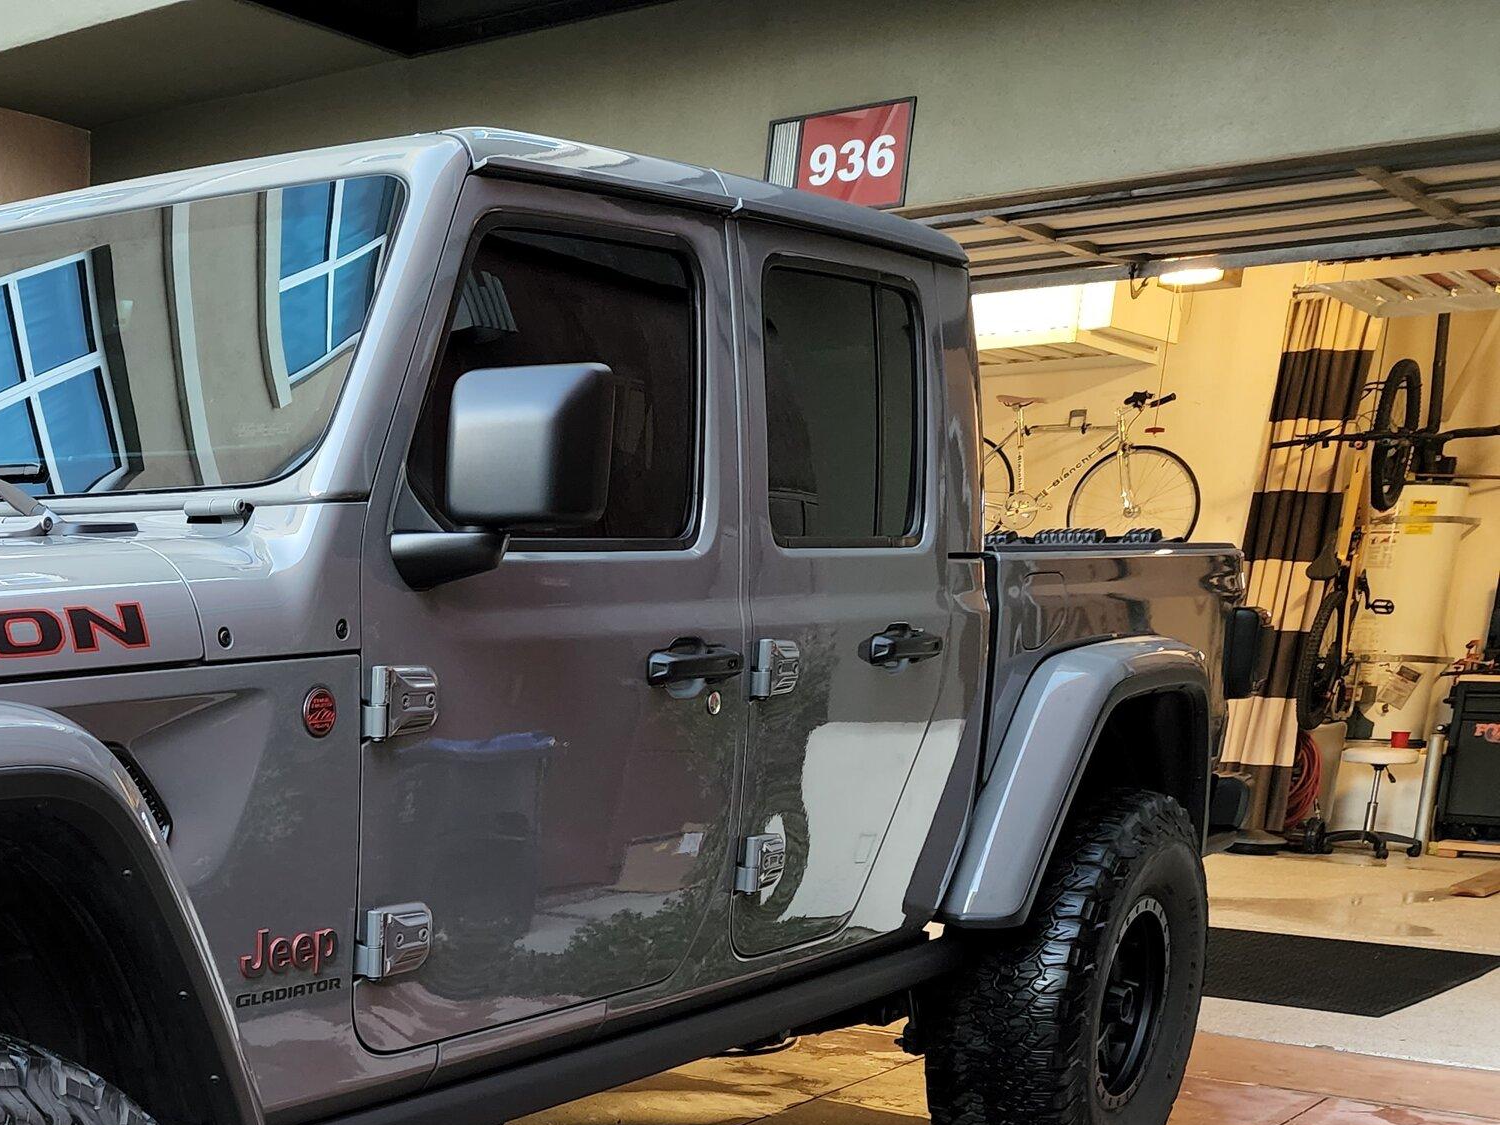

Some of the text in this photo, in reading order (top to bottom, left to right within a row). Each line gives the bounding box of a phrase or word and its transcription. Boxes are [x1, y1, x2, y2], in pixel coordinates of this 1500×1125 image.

[808, 134, 896, 186] 936
[238, 927, 339, 980] Jeep
[236, 977, 341, 1009] GLADIATOR
